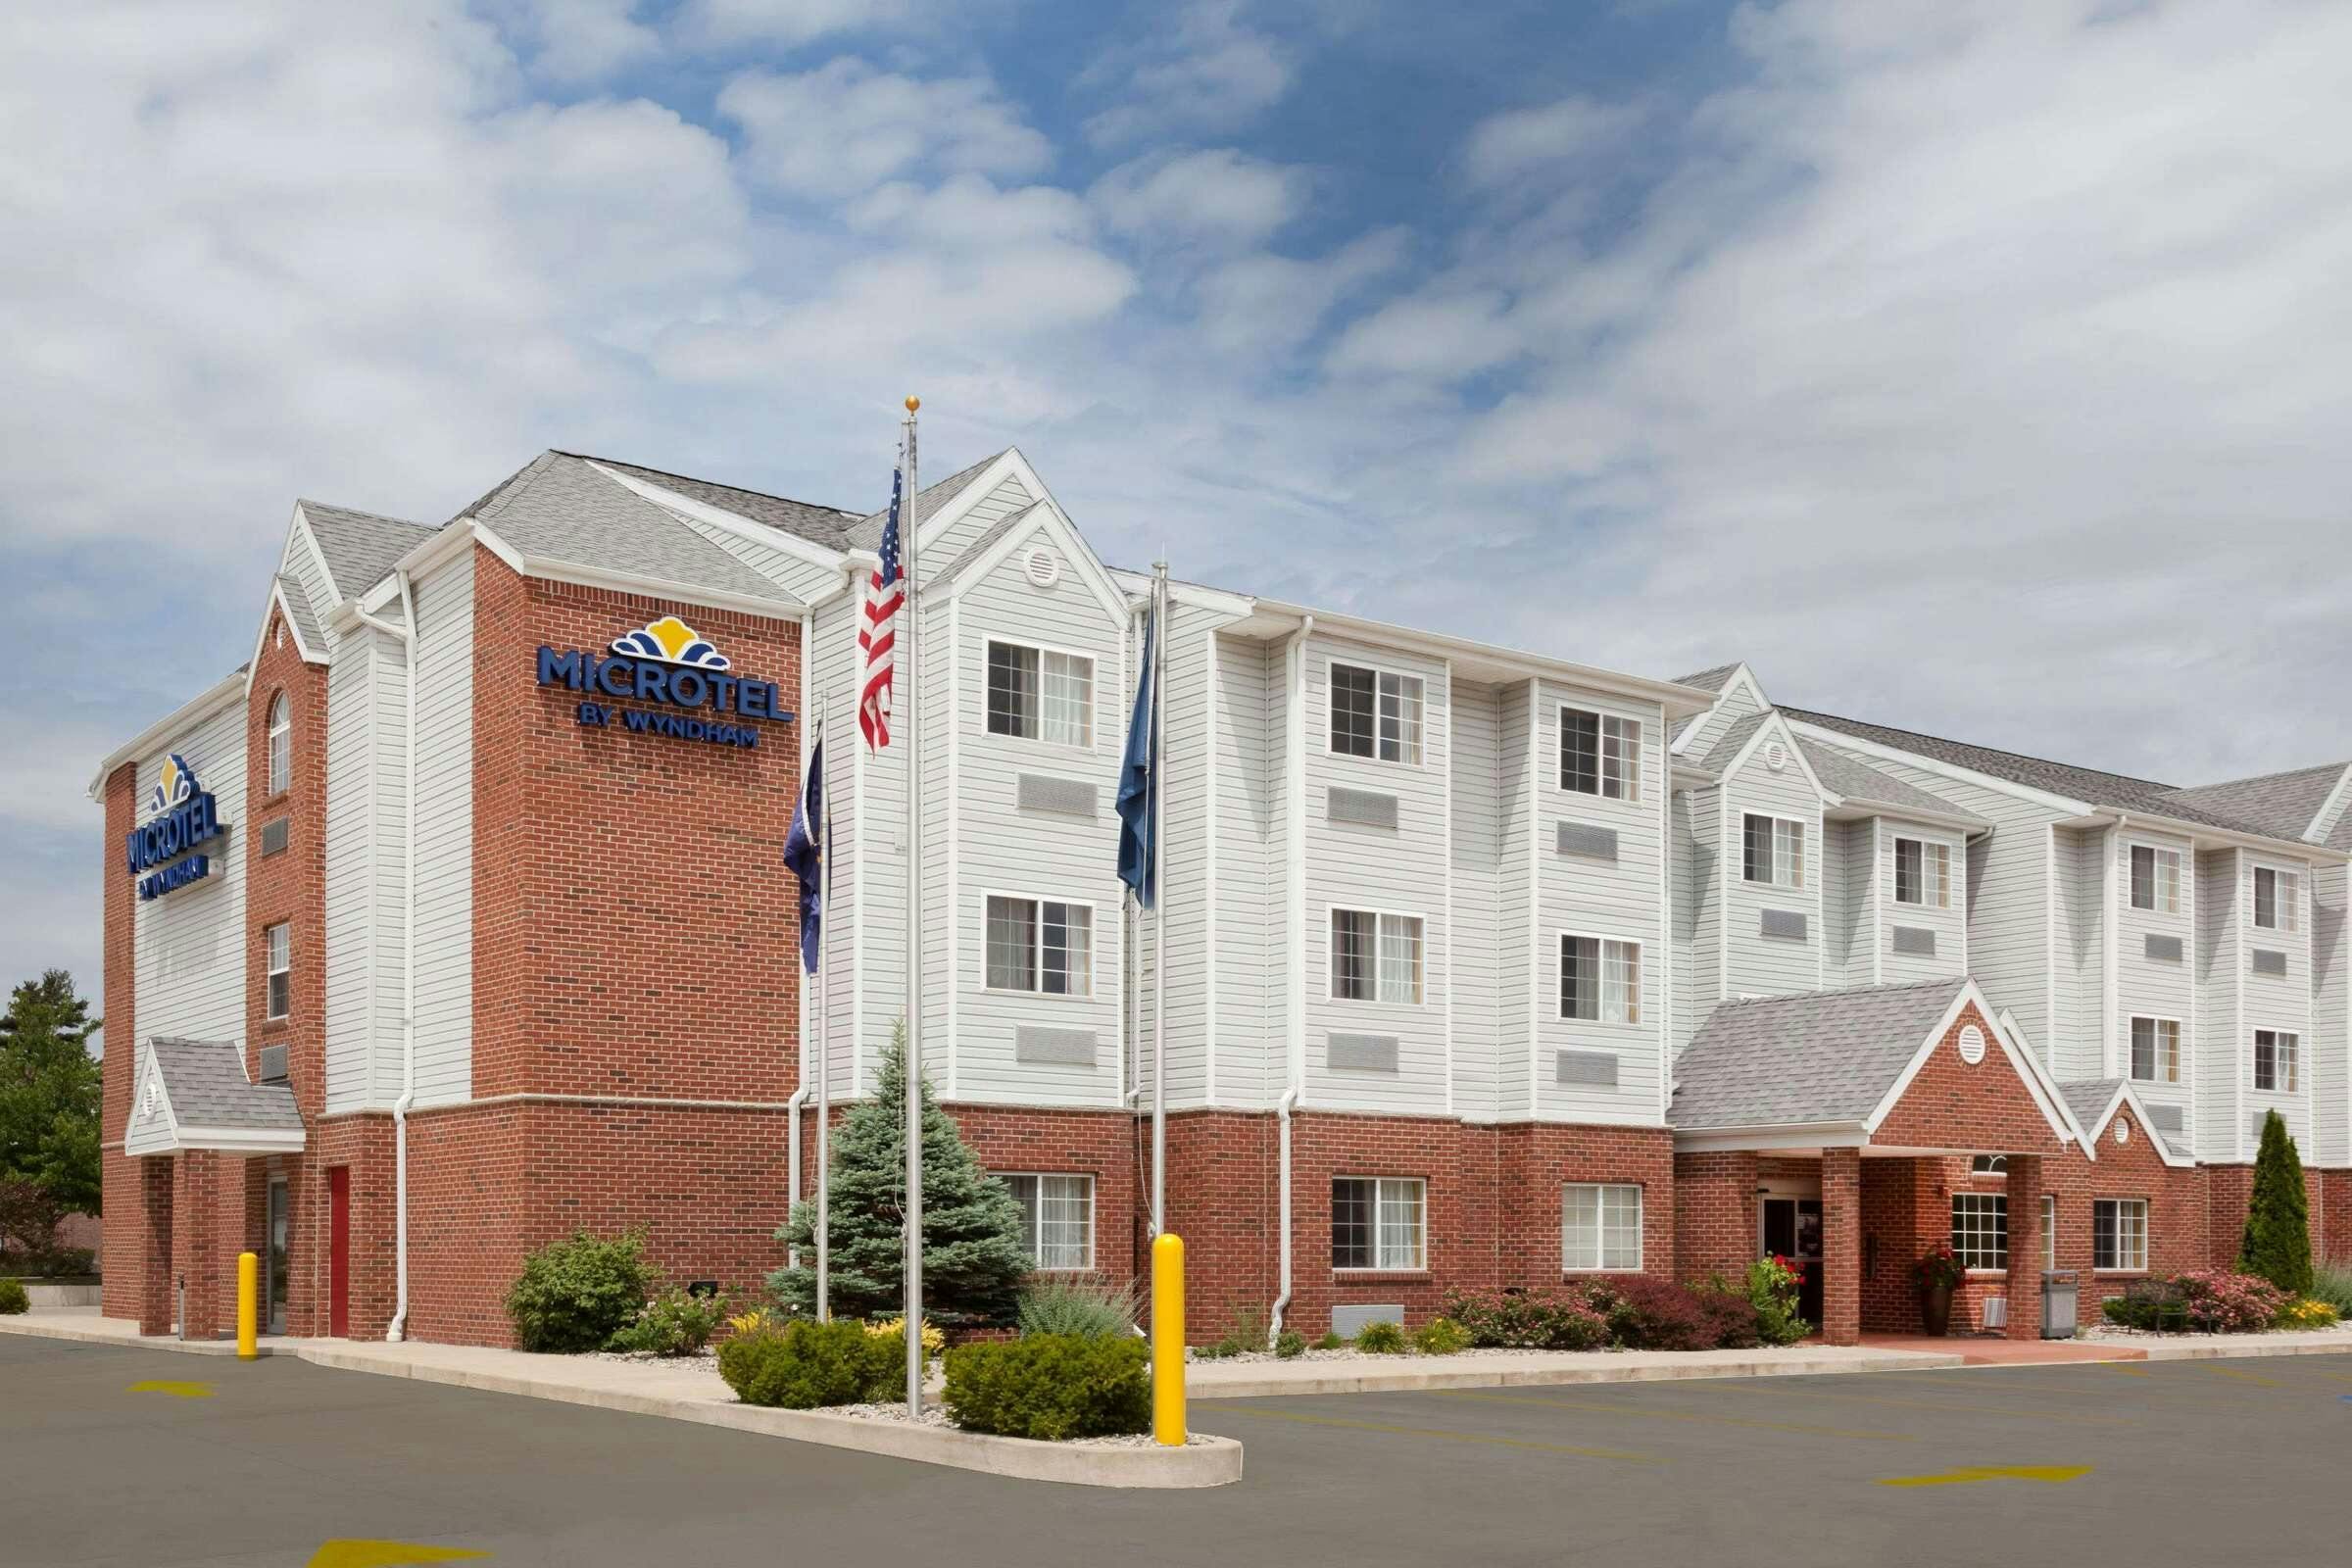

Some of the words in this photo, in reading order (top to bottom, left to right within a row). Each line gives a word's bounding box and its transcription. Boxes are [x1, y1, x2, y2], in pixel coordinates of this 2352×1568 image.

[538, 646, 794, 721] MICROTEL
[578, 702, 612, 726] BY
[624, 710, 759, 747] WYNDHAM
[125, 795, 216, 873] MICROTEL
